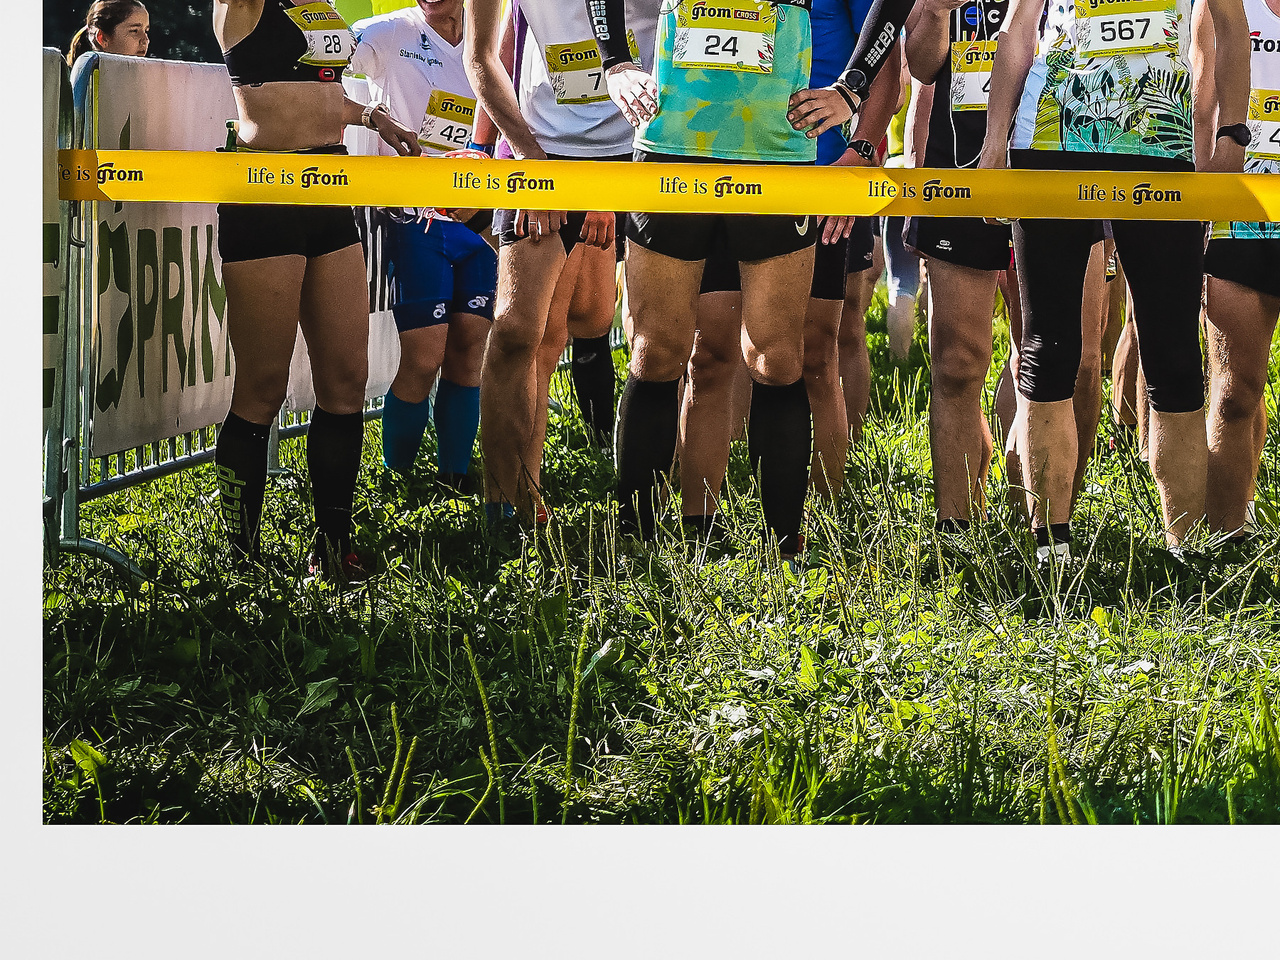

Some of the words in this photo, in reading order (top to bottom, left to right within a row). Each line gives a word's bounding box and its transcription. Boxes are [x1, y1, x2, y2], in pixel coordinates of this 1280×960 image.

[300, 9, 327, 24] grom
[689, 0, 732, 20] grom
[736, 11, 757, 20] CROSS
[1100, 18, 1151, 42] 567
[323, 33, 342, 54] 28
[704, 34, 739, 57] 24
[558, 48, 598, 66] grom
[440, 97, 474, 117] grom
[439, 124, 473, 145] 42
[76, 165, 91, 181] is
[96, 162, 144, 184] grom
[248, 167, 274, 184] life
[281, 169, 295, 185] is
[453, 171, 480, 189] life
[487, 173, 500, 190] is
[507, 171, 555, 192] grom
[659, 176, 687, 194] life
[694, 178, 707, 194] is
[714, 175, 763, 198] grom
[868, 180, 897, 198] life
[903, 182, 917, 198] is
[923, 179, 972, 202] grom
[1077, 183, 1106, 201] life
[1112, 185, 1126, 202] is
[1132, 183, 1182, 206] grom
[137, 224, 231, 399] PRIM
